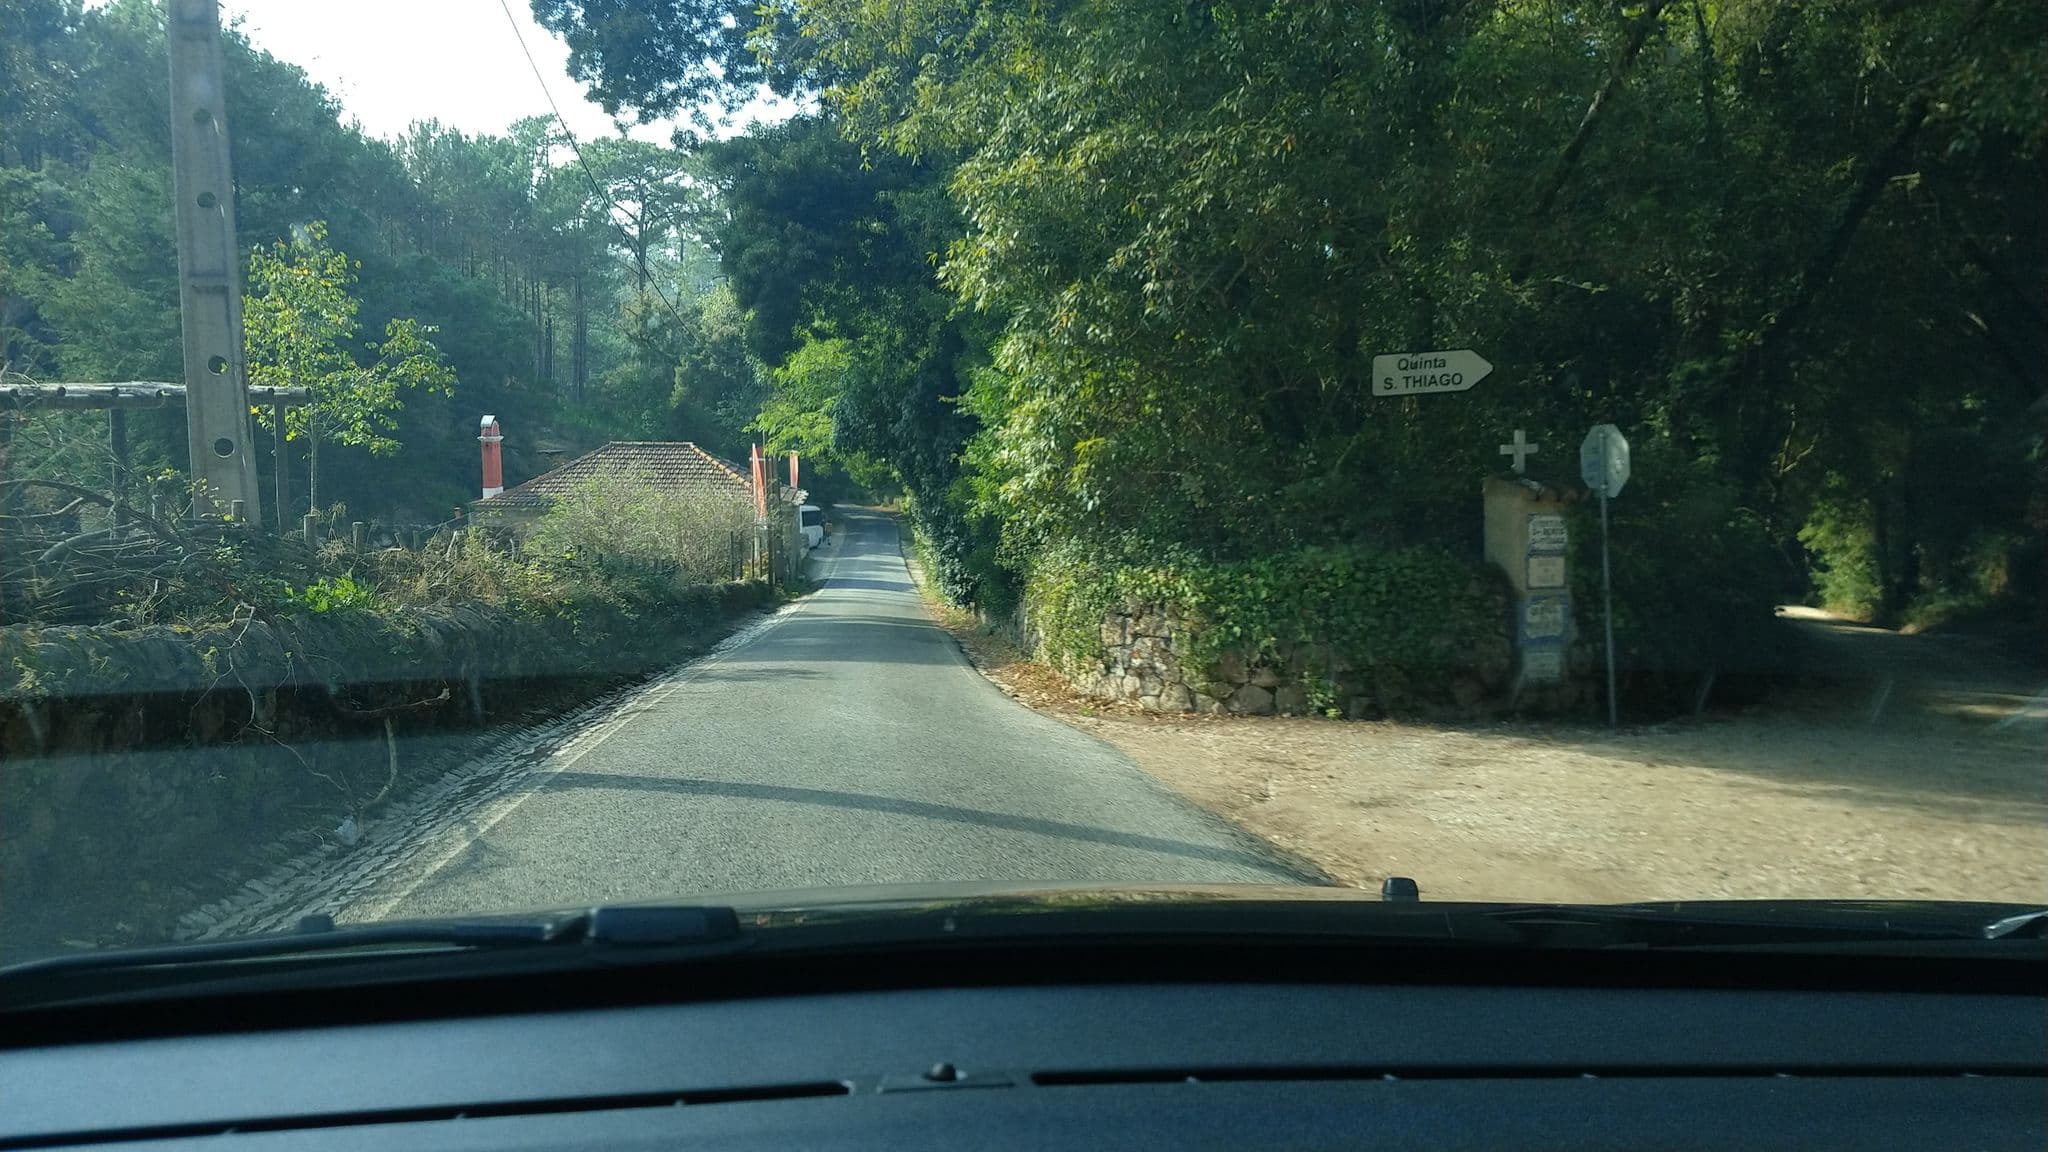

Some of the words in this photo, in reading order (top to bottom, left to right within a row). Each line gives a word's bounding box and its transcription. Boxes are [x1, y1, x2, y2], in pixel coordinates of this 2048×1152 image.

[1397, 357, 1447, 371] Quinta
[1384, 377, 1398, 390] S.
[1403, 373, 1463, 389] THIAGO
